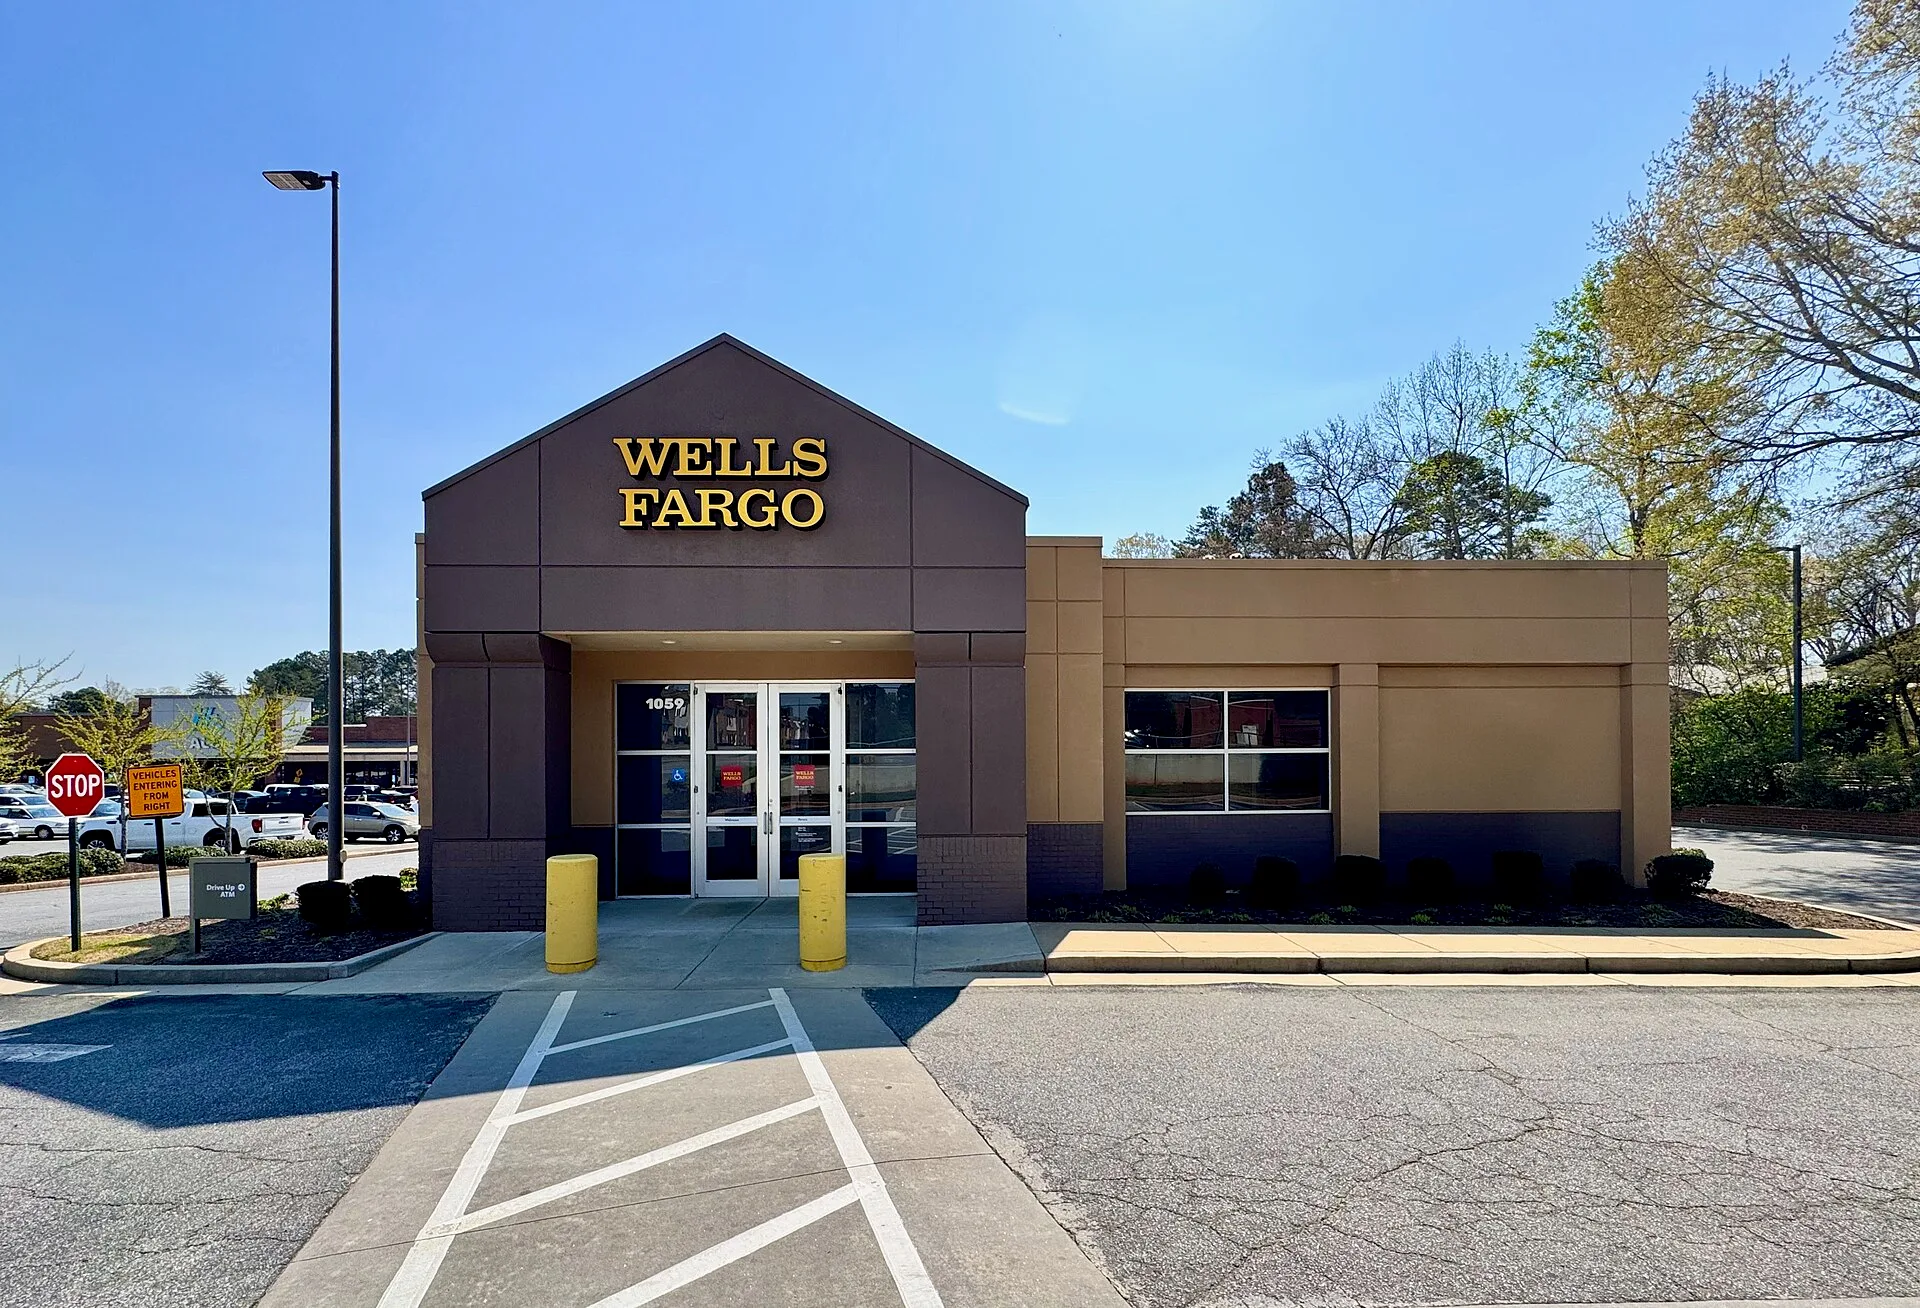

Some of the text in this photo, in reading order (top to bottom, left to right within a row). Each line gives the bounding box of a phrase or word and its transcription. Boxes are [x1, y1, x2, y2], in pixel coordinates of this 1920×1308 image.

[613, 437, 829, 479] WELLS
[618, 488, 826, 529] FARGO
[645, 697, 685, 710] 1059
[132, 769, 177, 780] VEHICLES
[51, 773, 101, 799] STOP
[133, 780, 178, 791] ENTERING
[143, 791, 169, 800] FROM
[143, 801, 171, 811] RIGHT
[225, 884, 235, 892] Up
